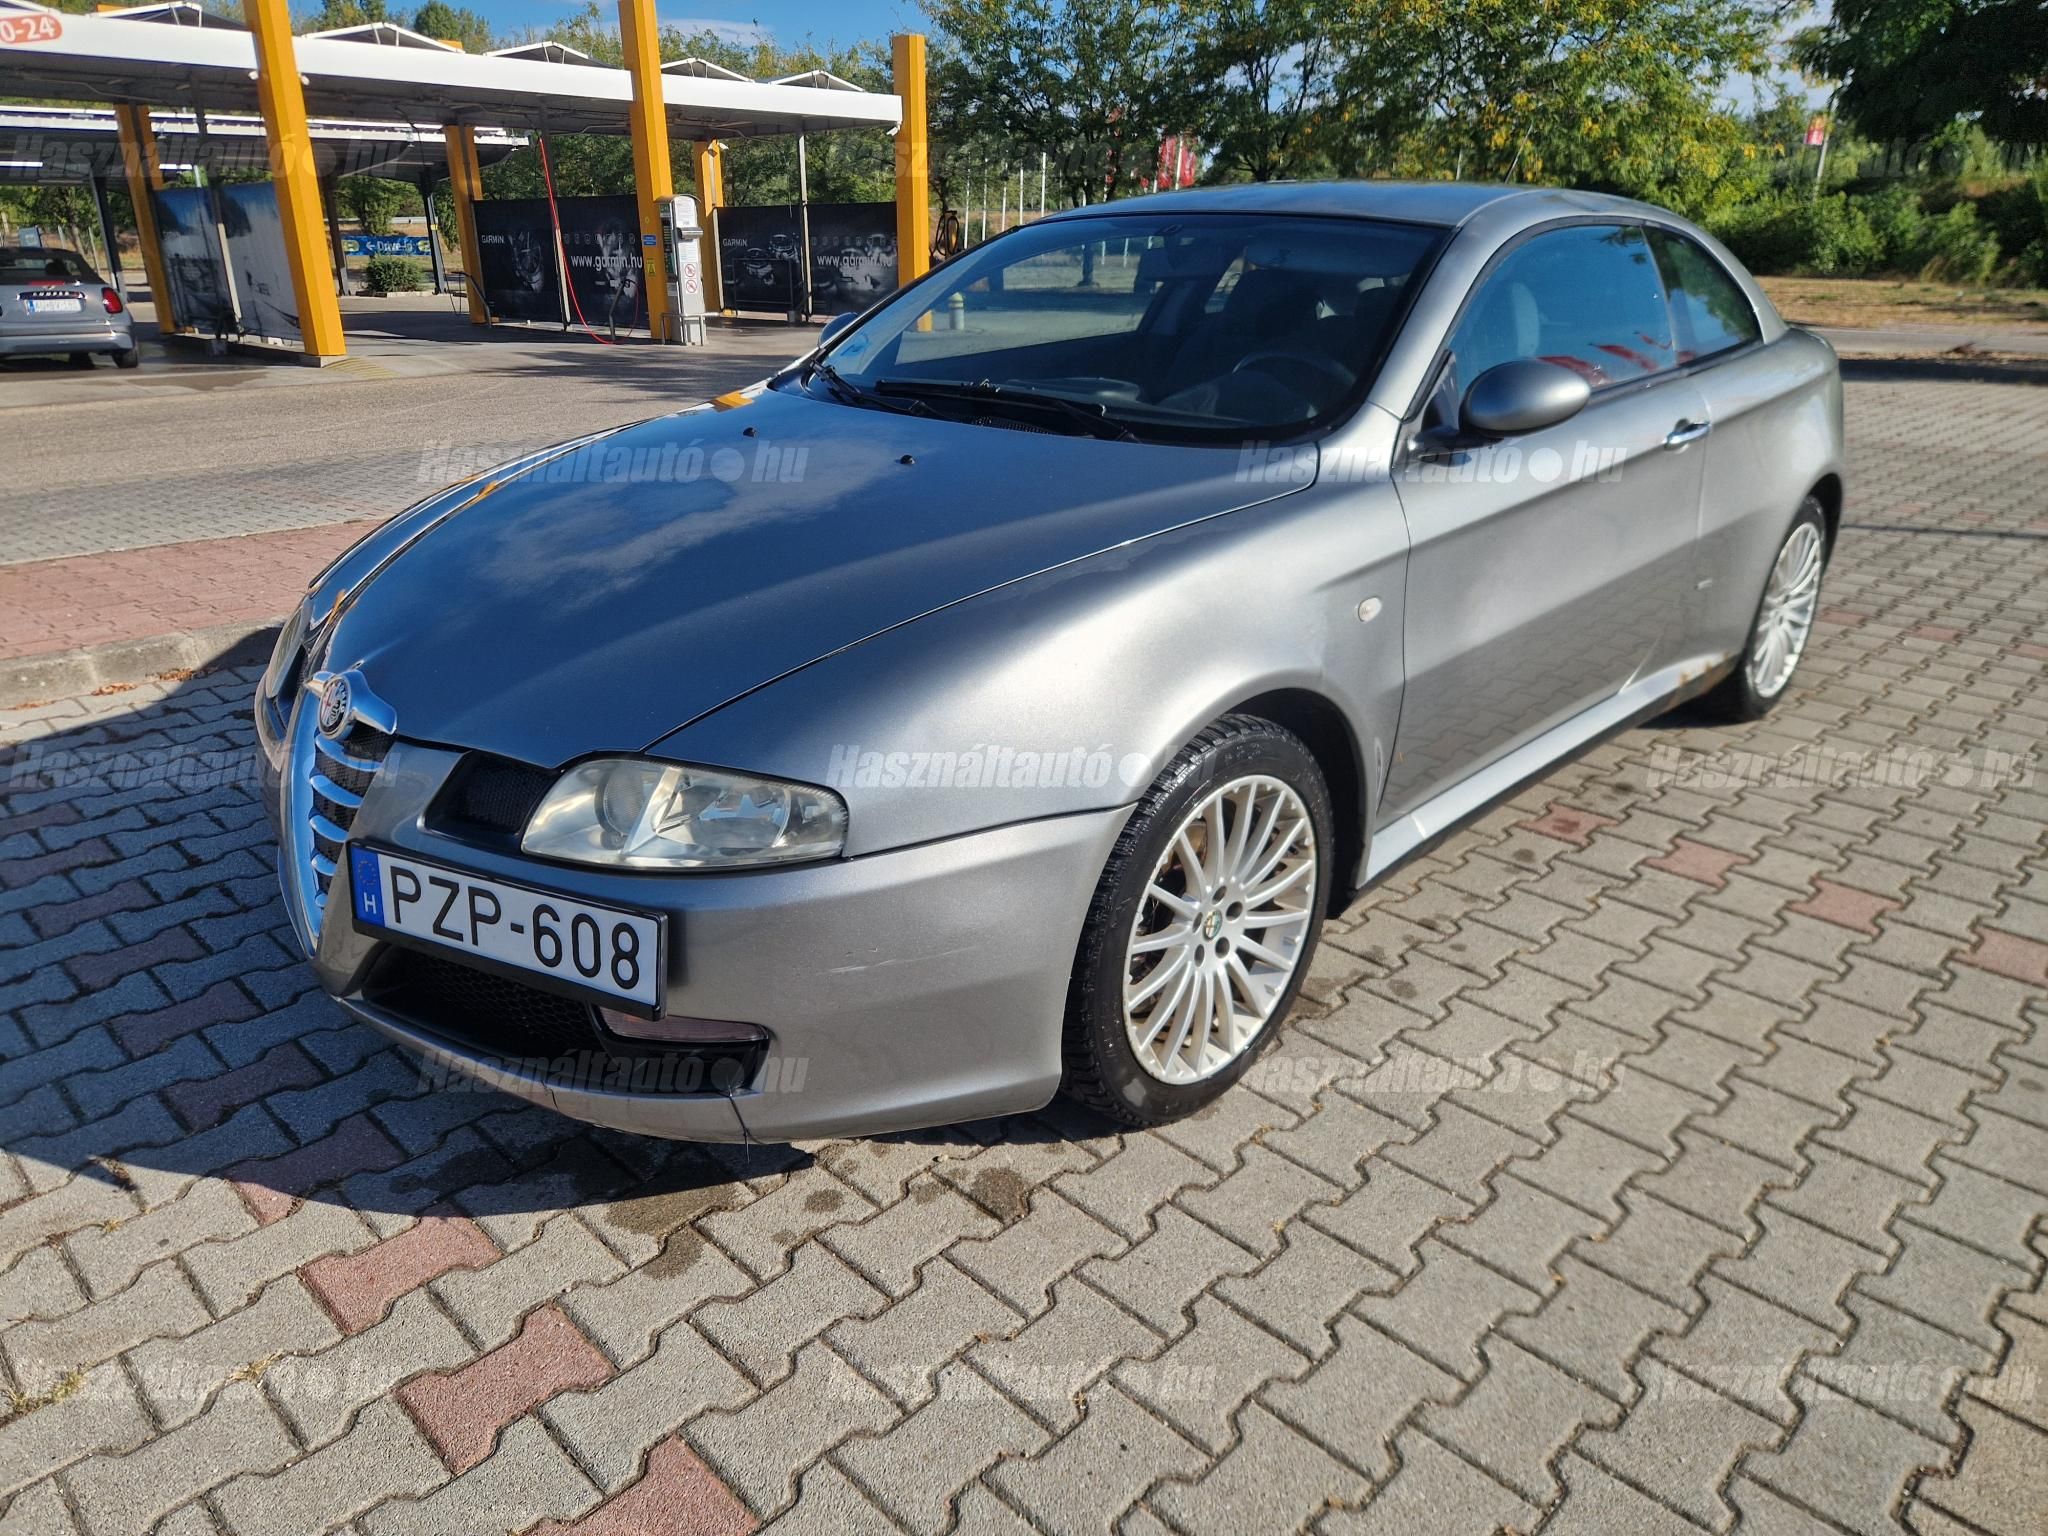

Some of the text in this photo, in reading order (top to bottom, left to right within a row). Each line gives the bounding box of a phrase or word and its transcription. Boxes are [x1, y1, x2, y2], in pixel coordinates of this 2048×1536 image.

[0, 15, 56, 43] 0-24
[481, 234, 505, 244] GARMIN
[722, 238, 748, 247] GARMIN
[571, 253, 643, 269] www.garmin.hu
[363, 891, 377, 915] H
[389, 864, 640, 990] PZP-608
